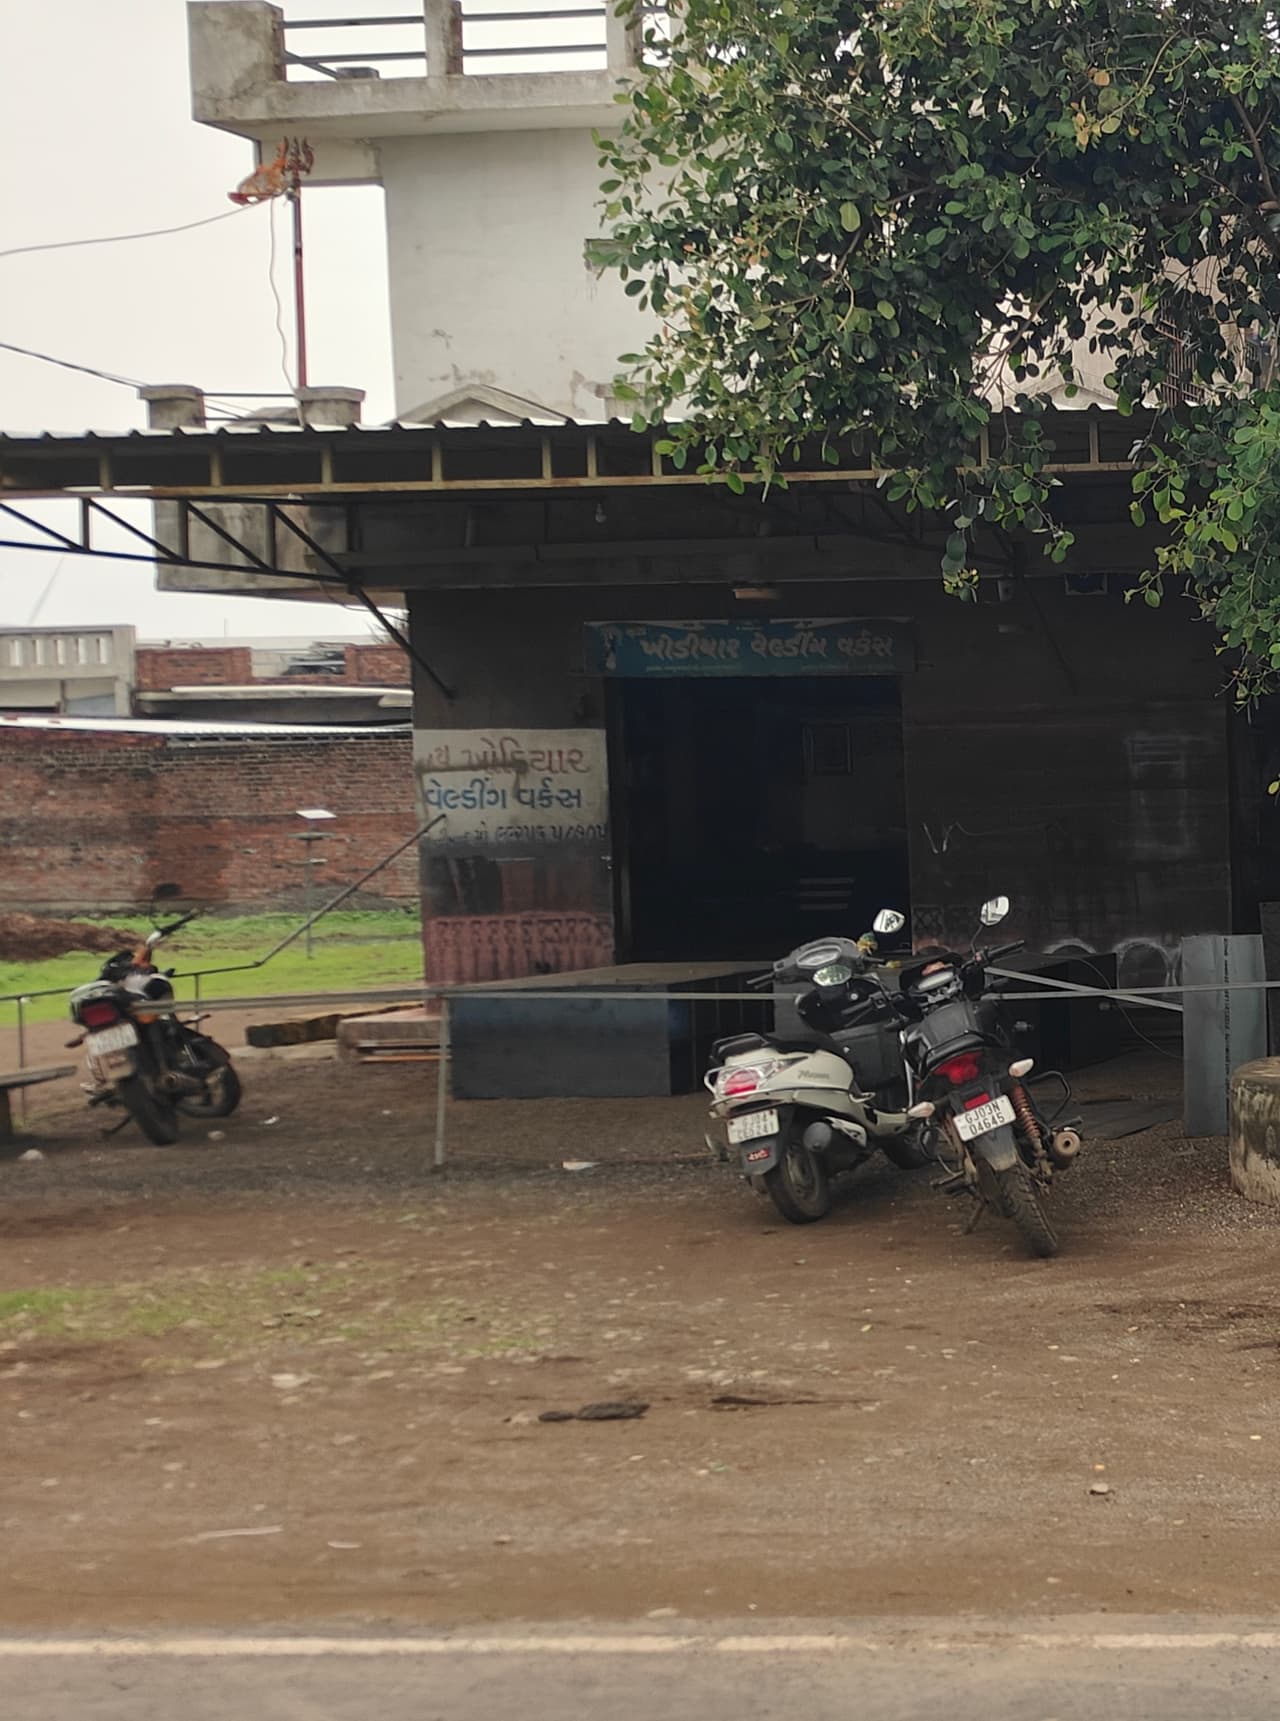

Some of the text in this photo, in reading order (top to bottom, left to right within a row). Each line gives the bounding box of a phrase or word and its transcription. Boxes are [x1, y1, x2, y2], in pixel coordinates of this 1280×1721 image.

[424, 777, 583, 810] વેલ્ડીંગ વર્કસ
[964, 1100, 1001, 1124] GJ03N
[969, 1112, 1006, 1136] 04645
